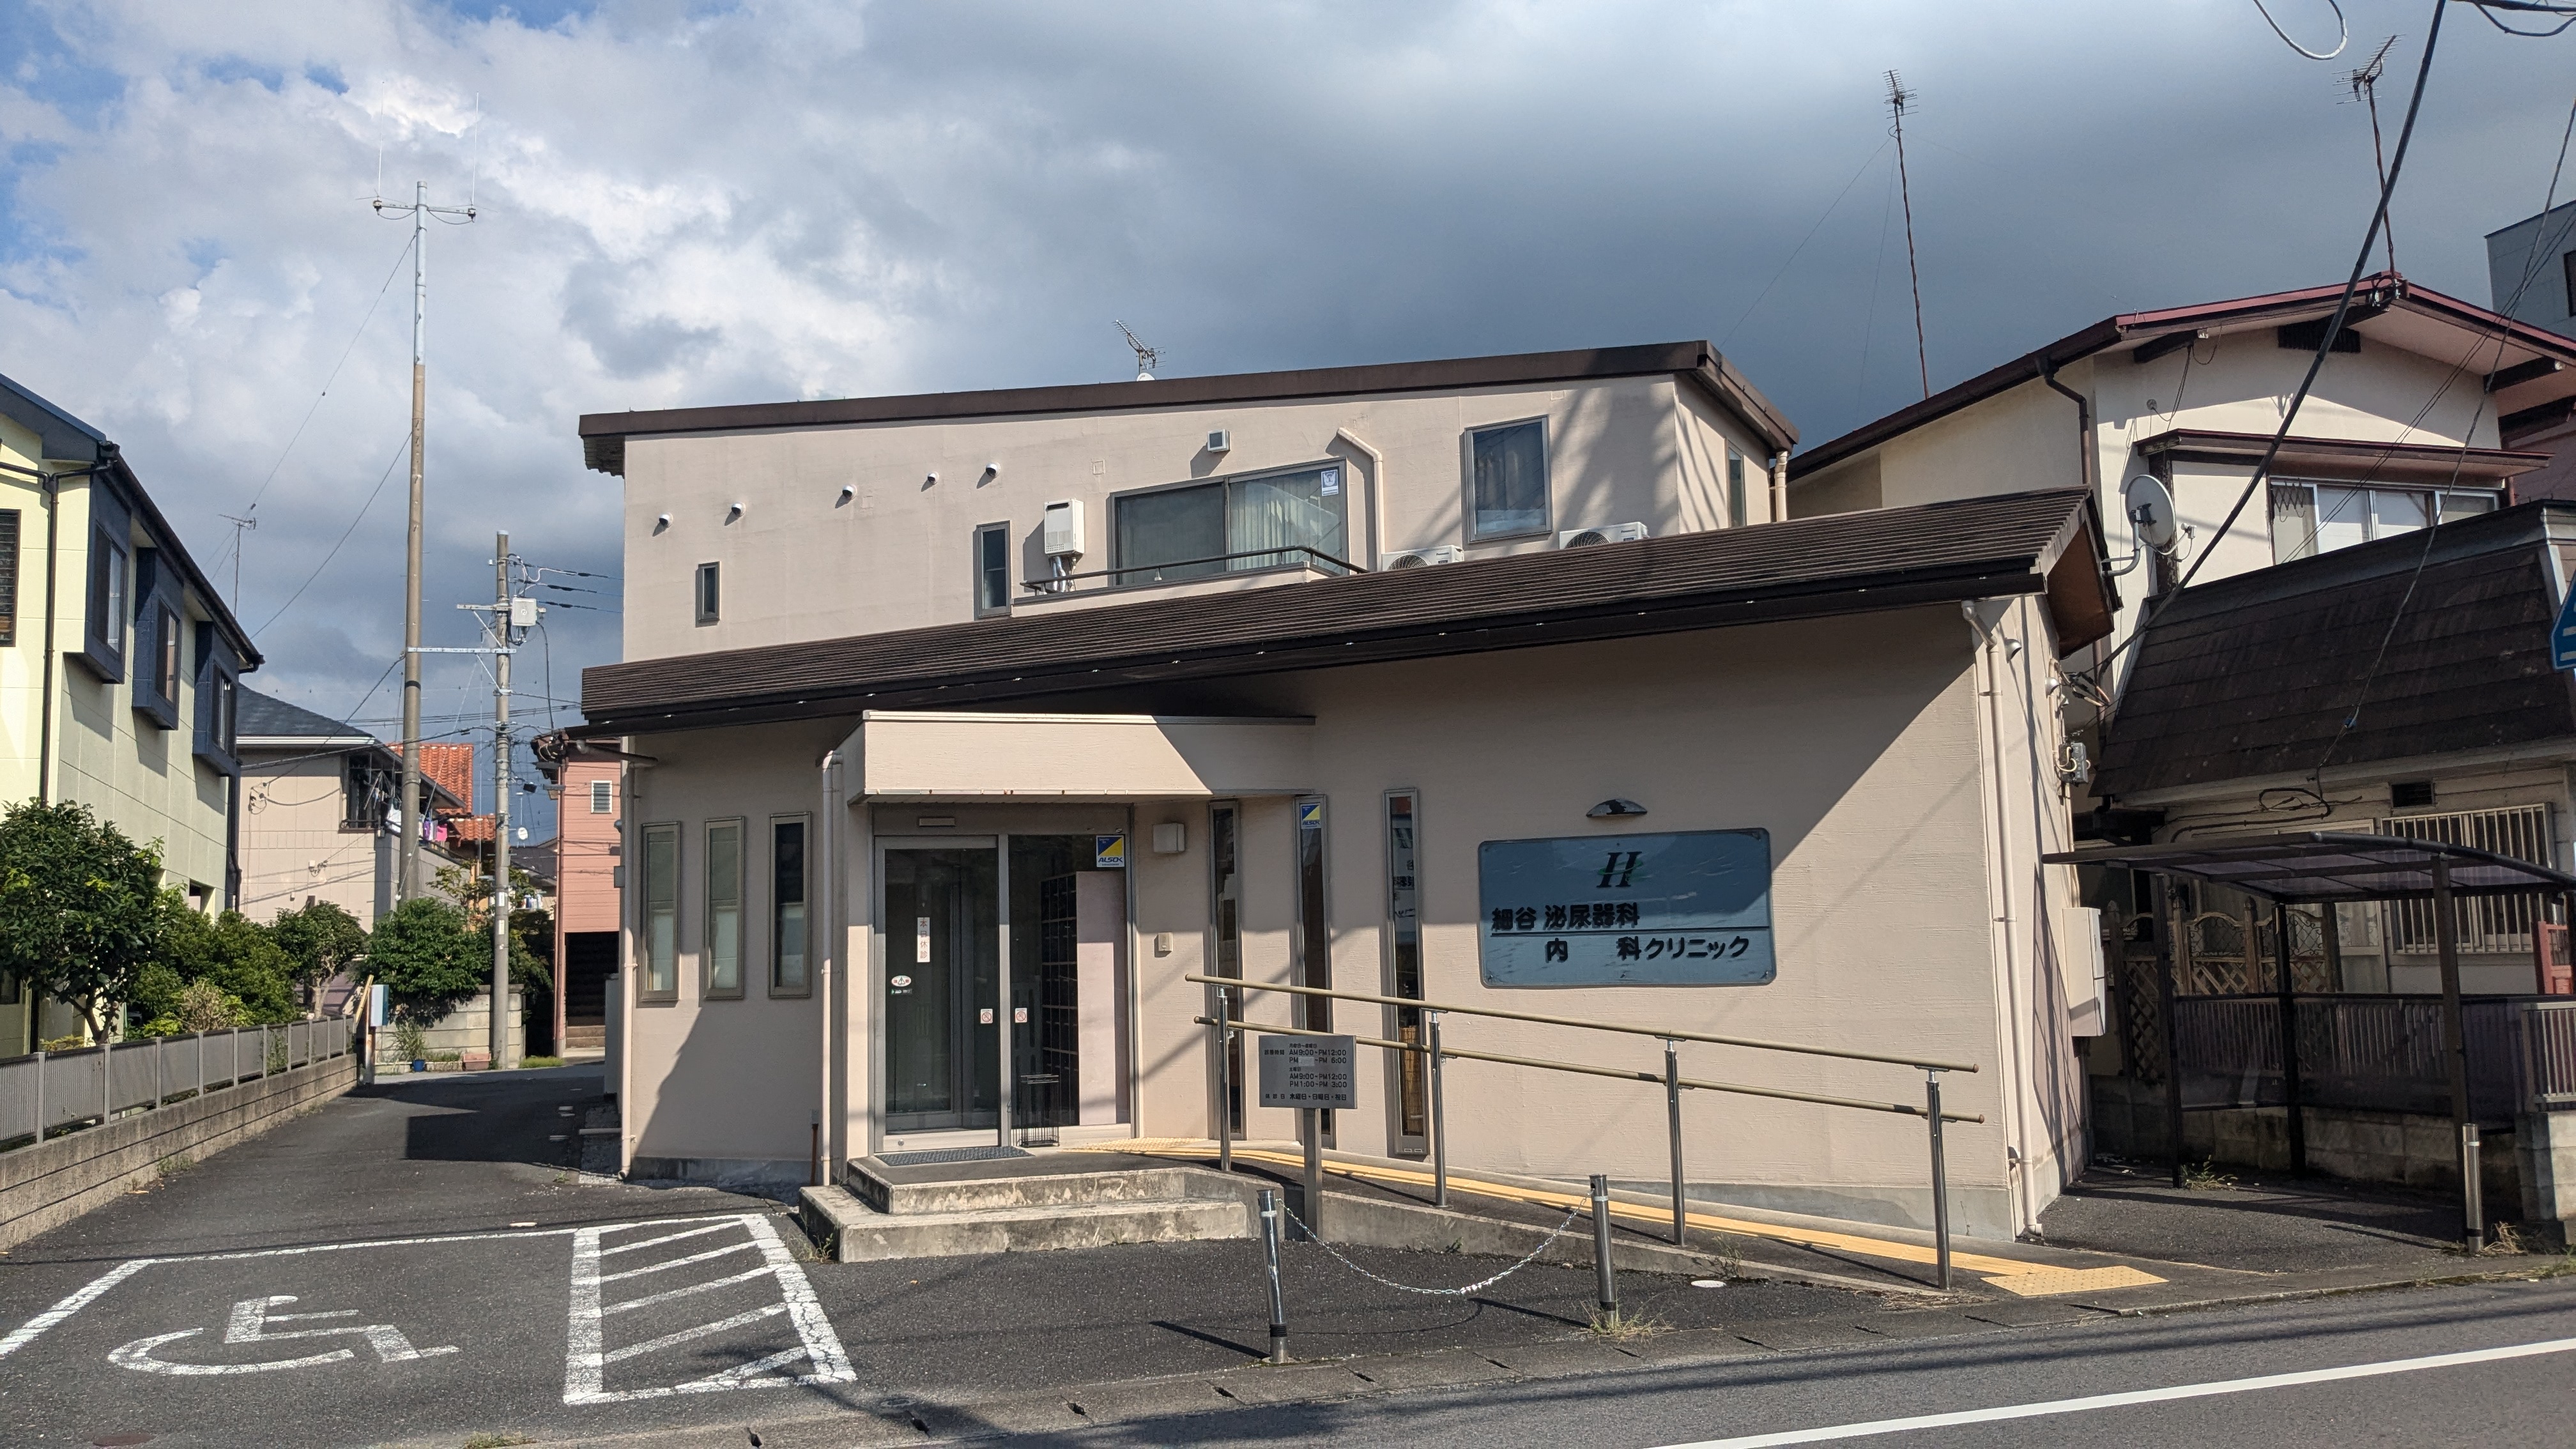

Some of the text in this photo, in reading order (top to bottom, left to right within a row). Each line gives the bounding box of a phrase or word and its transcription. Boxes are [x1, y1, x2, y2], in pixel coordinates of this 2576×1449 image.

[1597, 851, 1642, 888] H
[1545, 902, 1640, 930] 泌尿器科
[919, 919, 928, 959] 本日休診
